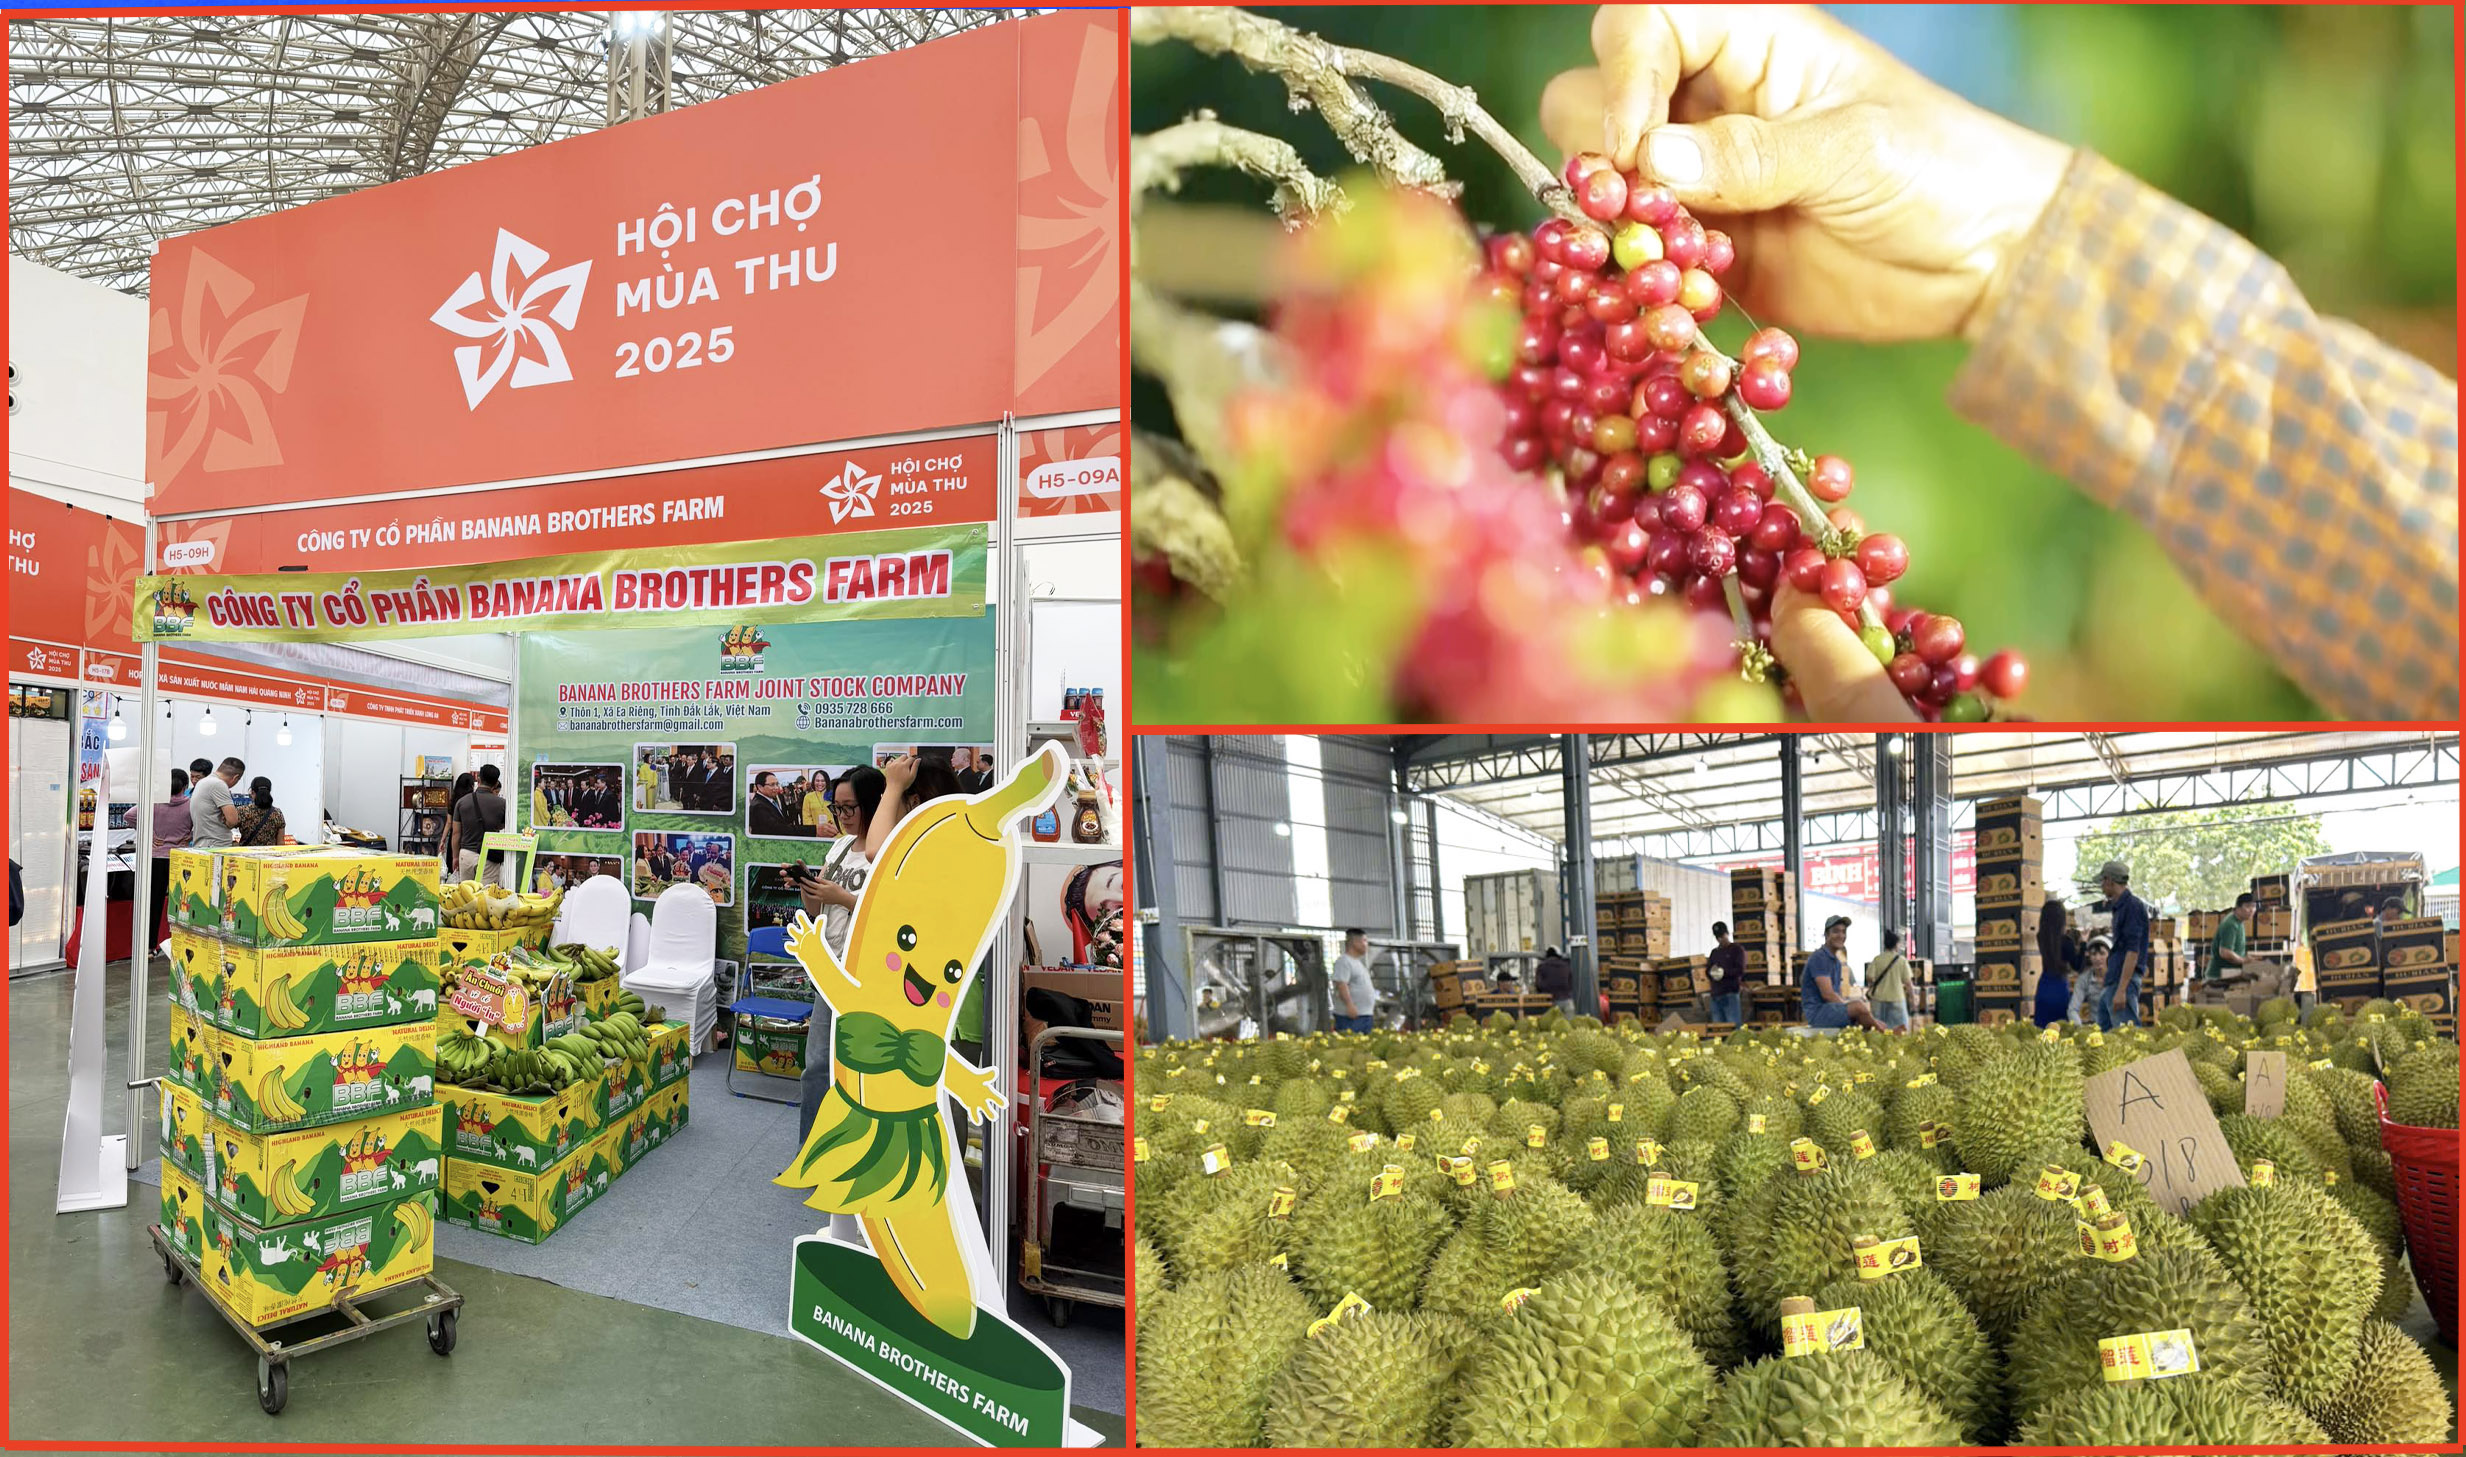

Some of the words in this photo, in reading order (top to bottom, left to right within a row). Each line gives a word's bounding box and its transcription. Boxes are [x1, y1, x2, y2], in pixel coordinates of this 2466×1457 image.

[616, 203, 696, 260] HỘI
[711, 173, 823, 232] CHỢ
[616, 260, 720, 317] MÙA
[735, 242, 839, 295] THU
[615, 326, 735, 378] 2025
[890, 459, 919, 477] HỘI
[924, 453, 963, 473] CHỢ
[890, 478, 928, 496] MÙA
[932, 476, 967, 492] THU
[1039, 468, 1120, 489] H5-09A
[890, 500, 933, 516] 2025
[298, 529, 344, 553] CÔNG
[350, 529, 371, 549] TY
[375, 518, 400, 546] CỔ
[405, 515, 455, 545] PHẦN
[462, 514, 541, 540] BANANA
[547, 503, 655, 533] BROTHERS
[662, 496, 724, 523] FARM
[169, 547, 209, 561] H5-09H
[207, 586, 281, 627] CÔNG
[280, 595, 316, 628] TY
[321, 581, 366, 626] CỔ
[370, 578, 460, 624] PHẦN
[469, 575, 603, 619] BANANA
[614, 563, 814, 610] BROTHERS
[826, 553, 950, 600] FARM
[721, 654, 764, 671] BBF
[559, 683, 616, 702] BANANA
[621, 681, 700, 700] BROTHERS
[706, 680, 750, 699] FARM
[755, 679, 805, 699] JOINT
[810, 677, 868, 698] STOCK
[872, 674, 967, 697] COMPANY
[570, 707, 591, 718] Thôn
[603, 707, 614, 718] Xã
[616, 707, 626, 717] Ea
[629, 705, 658, 719] Riêng,
[725, 704, 746, 718] Việt
[748, 705, 771, 716] Nam
[815, 703, 844, 715] 0935
[846, 703, 868, 714] 728
[871, 703, 893, 714] 666
[570, 719, 724, 732] bananabrothersfarm@gmail.com
[815, 716, 963, 729] Bananabrothersfarm.com
[333, 905, 381, 928] BBF
[335, 990, 384, 1016] BBF
[392, 1028, 418, 1036] NATURAL
[2255, 1057, 2271, 1088] A
[333, 1079, 382, 1107] BBF
[2119, 1071, 2164, 1125] A
[400, 1111, 427, 1122] NATURAL
[456, 1130, 491, 1151] BBF
[340, 1165, 387, 1197] BBF
[324, 1222, 372, 1255] BBF
[813, 1304, 875, 1353] BANANA
[879, 1340, 969, 1404] BROTHERS
[973, 1392, 1030, 1437] FARM
